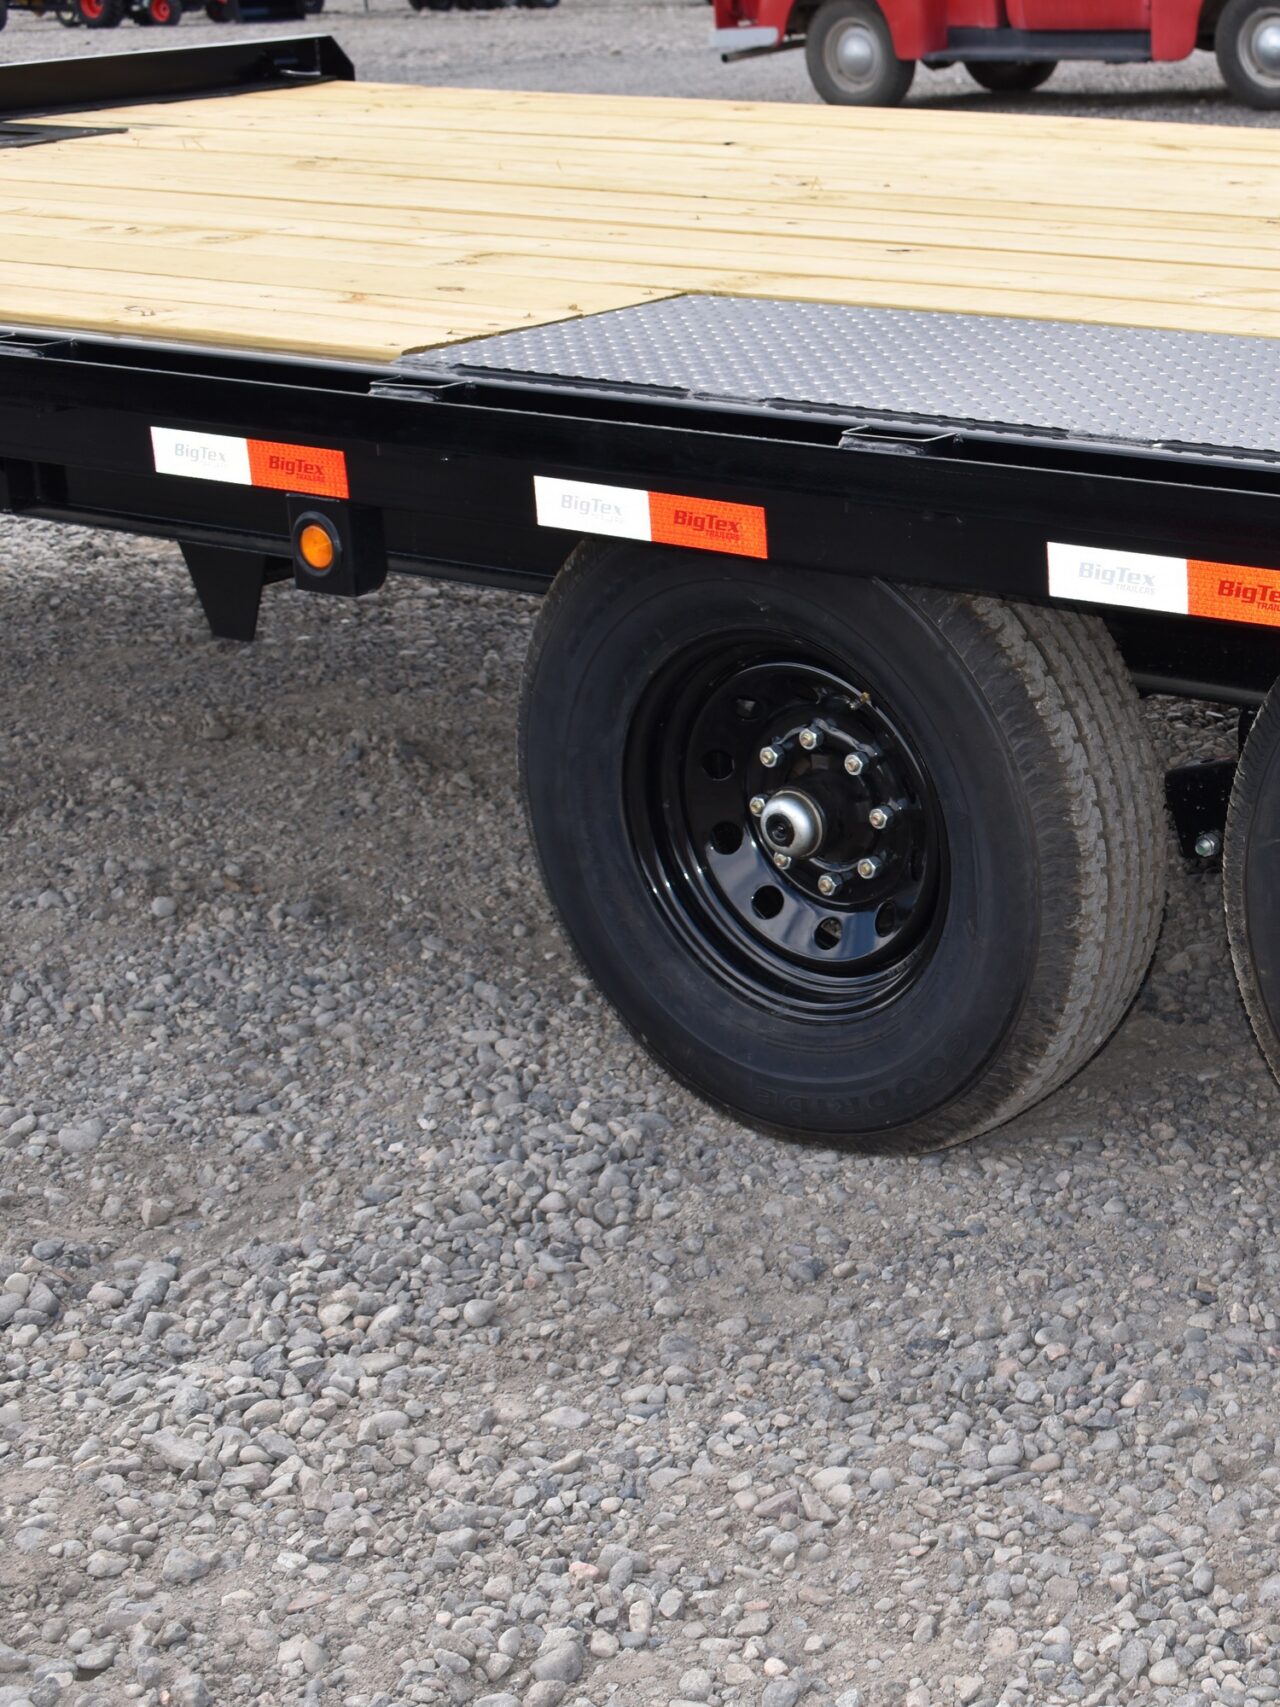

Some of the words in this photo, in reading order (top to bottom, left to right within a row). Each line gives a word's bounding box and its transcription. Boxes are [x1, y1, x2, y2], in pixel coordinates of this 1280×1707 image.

[174, 443, 226, 462] BigTex
[268, 455, 325, 476] BigTex
[560, 494, 623, 516] BigTex
[673, 509, 742, 533] BigTex
[705, 529, 741, 542] TRAILERS
[1078, 561, 1157, 587] BigTex
[1115, 582, 1157, 595] TRAILERS
